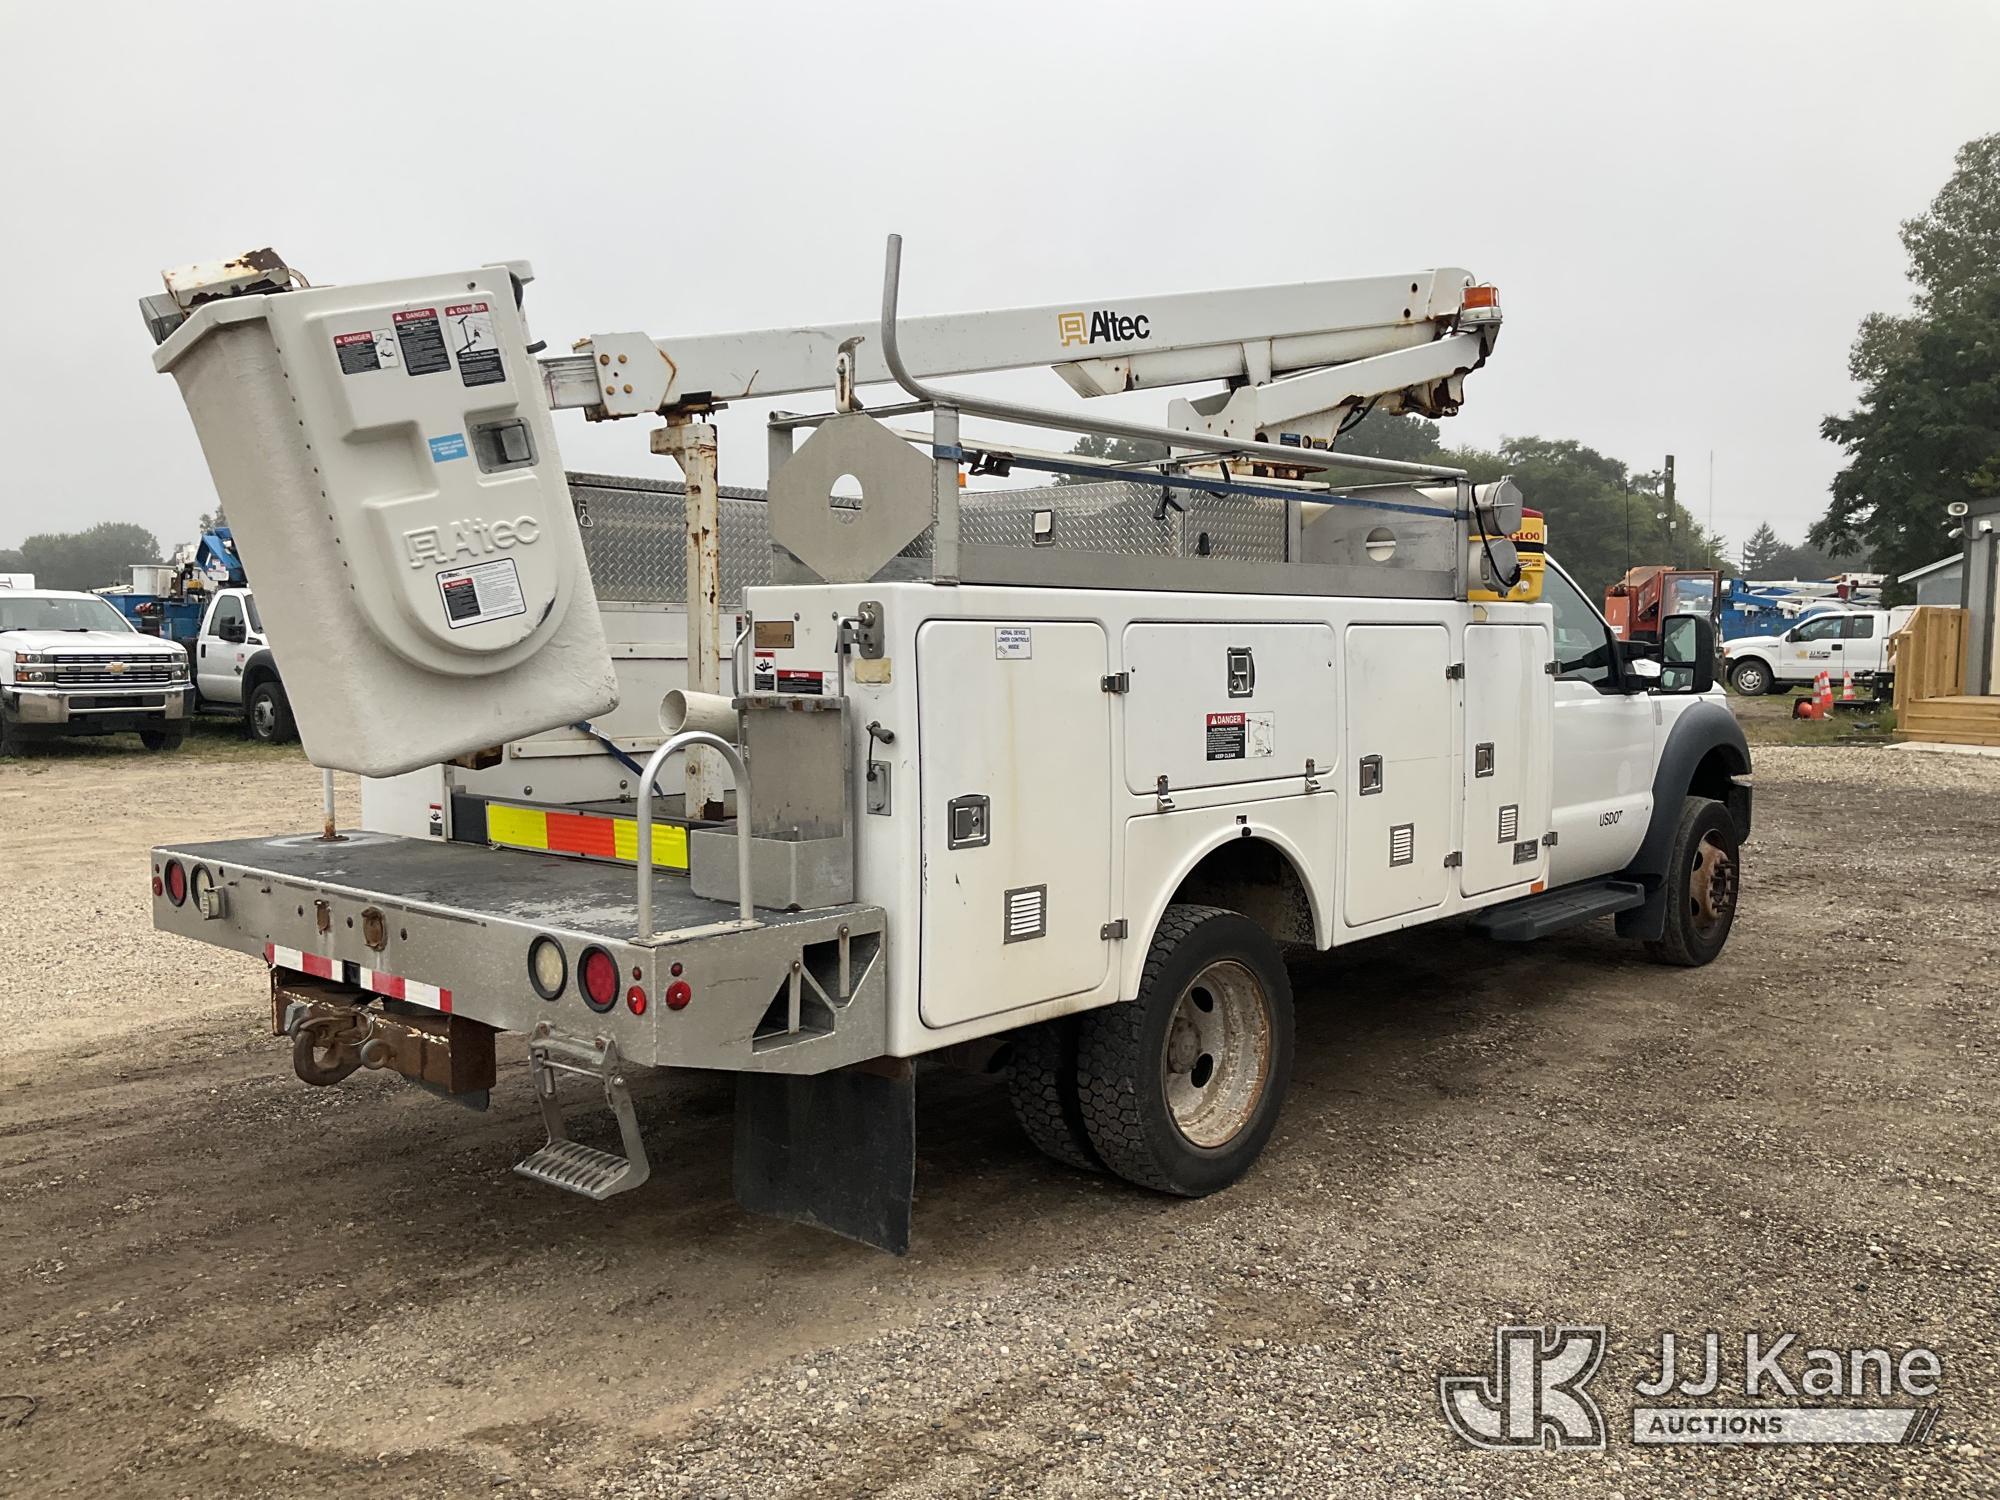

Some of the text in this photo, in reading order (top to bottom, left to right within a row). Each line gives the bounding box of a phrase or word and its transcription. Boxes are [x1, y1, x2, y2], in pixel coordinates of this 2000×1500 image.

[405, 310, 431, 320] DANGER
[1089, 310, 1150, 344] Altec
[343, 333, 372, 343] DANGER
[449, 515, 540, 561] Altec
[1217, 715, 1242, 725] DANGER
[1599, 810, 1623, 827] USDOT
